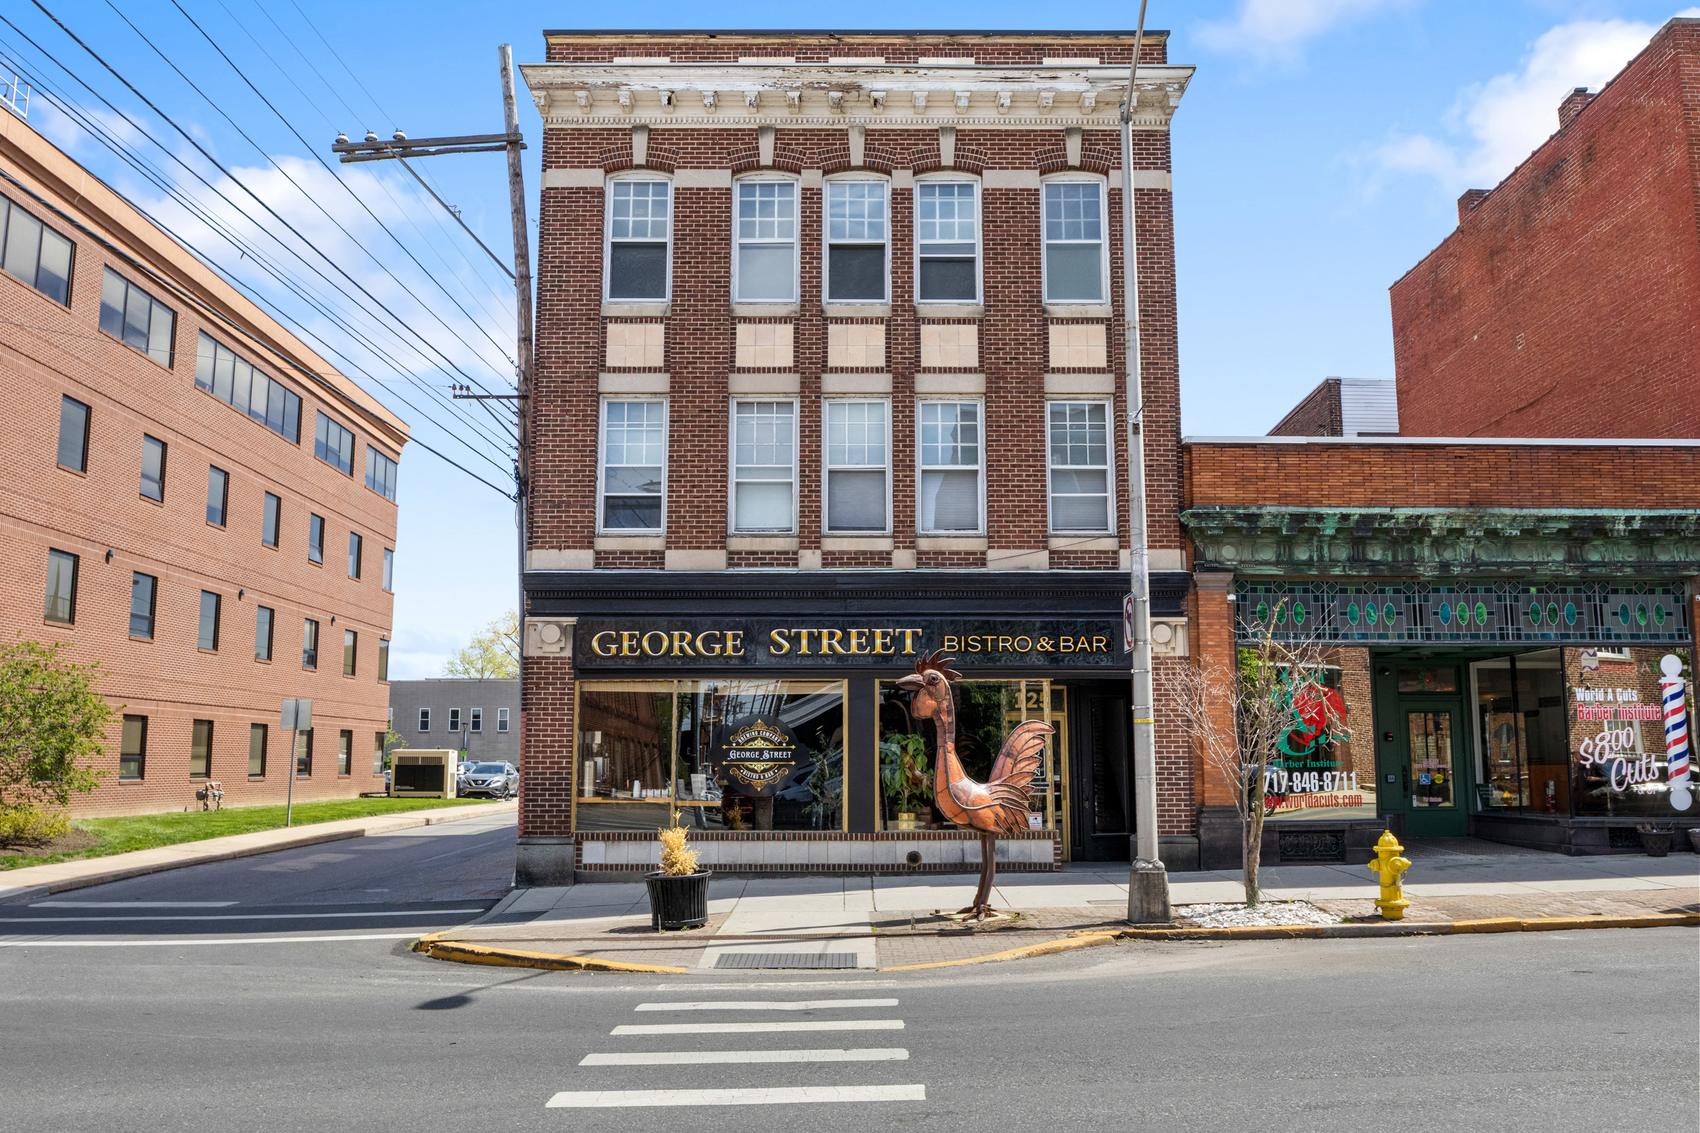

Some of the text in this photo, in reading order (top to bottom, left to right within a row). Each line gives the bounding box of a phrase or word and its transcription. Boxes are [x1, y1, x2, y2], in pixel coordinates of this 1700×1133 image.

[591, 630, 745, 656] GEORGE
[769, 628, 923, 655] STREET
[1575, 688, 1638, 701] World A Cuts
[1577, 703, 1614, 720] Barber
[738, 731, 781, 744] BREWING COMPANY
[1272, 759, 1304, 768] rber
[1611, 754, 1659, 791] Cuts
[1264, 771, 1357, 793] 717-846-8711
[1264, 793, 1363, 808] ww.worldacuts.com
